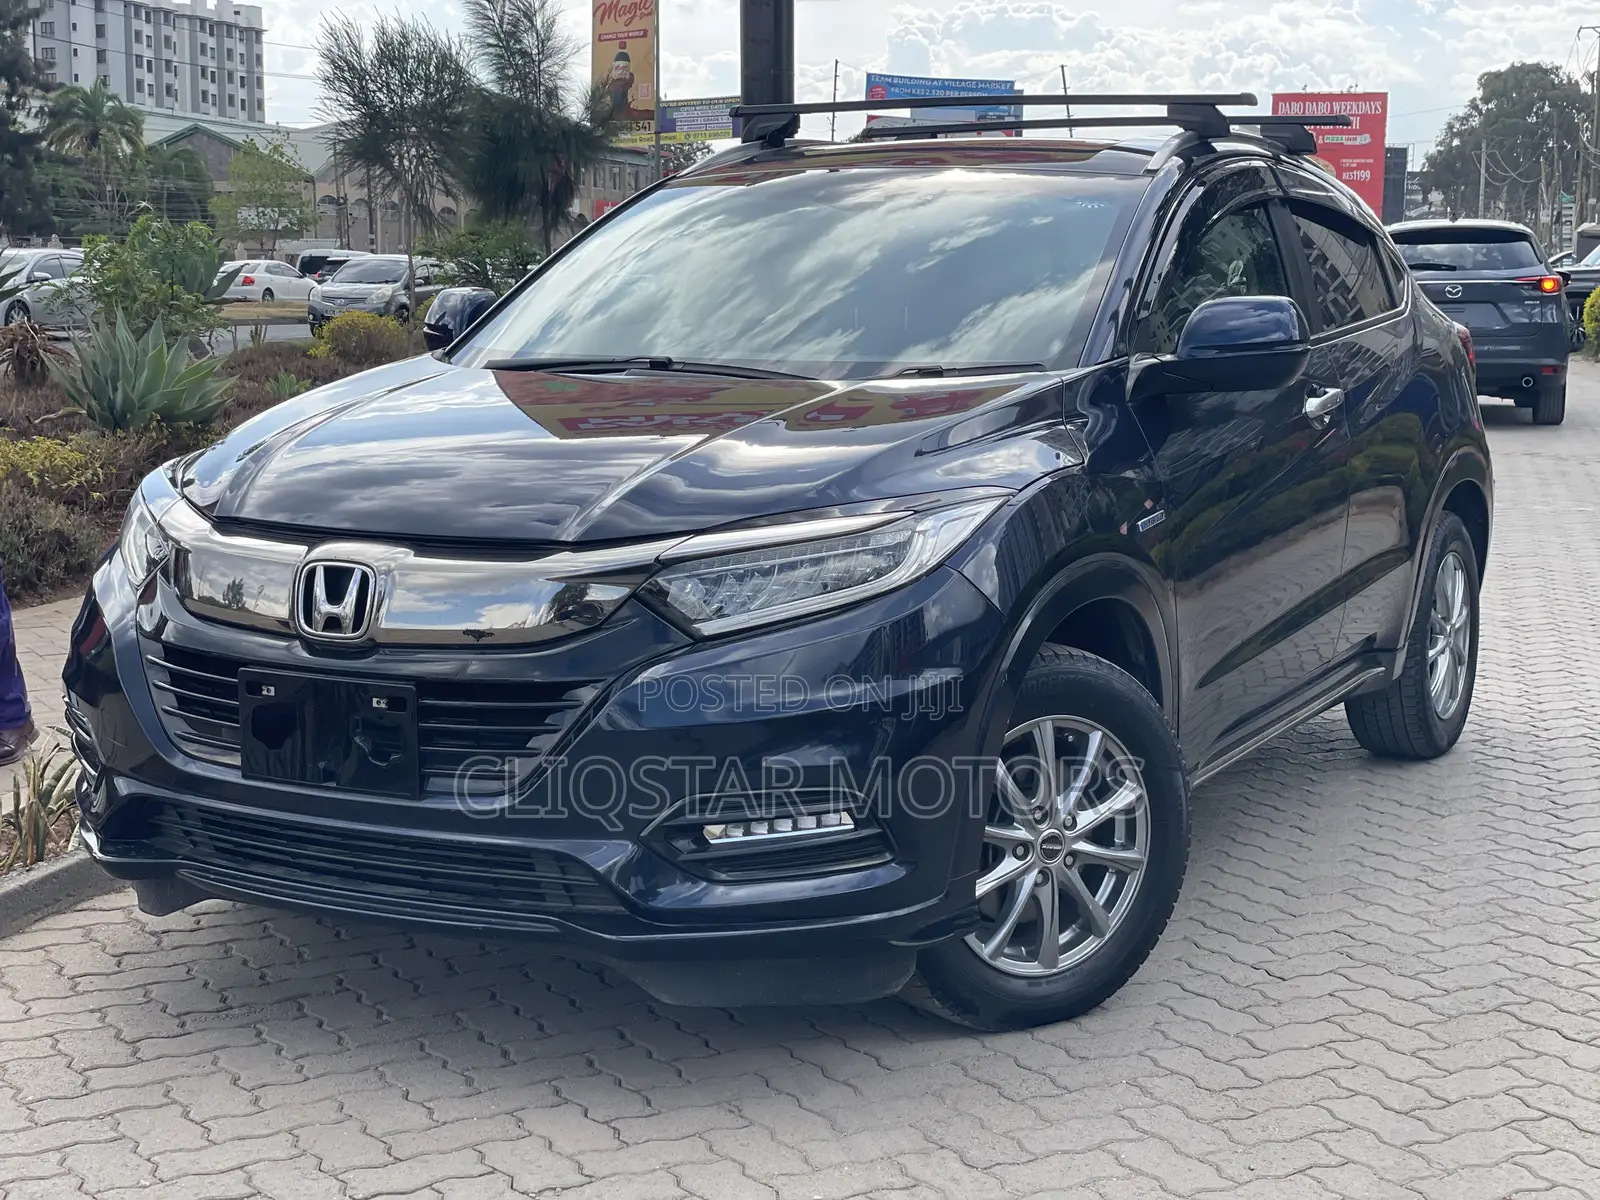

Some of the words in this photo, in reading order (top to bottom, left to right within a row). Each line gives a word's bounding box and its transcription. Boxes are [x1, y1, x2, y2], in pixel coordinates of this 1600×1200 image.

[871, 75, 892, 83] TEAM
[893, 76, 931, 85] BUILDING
[944, 80, 977, 89] VILLAGE
[977, 82, 1011, 90] MARKET
[678, 99, 701, 107] INVITED
[1278, 101, 1303, 115] DABO
[1305, 101, 1330, 115] DABO
[1332, 101, 1382, 114] WEEKDAYS
